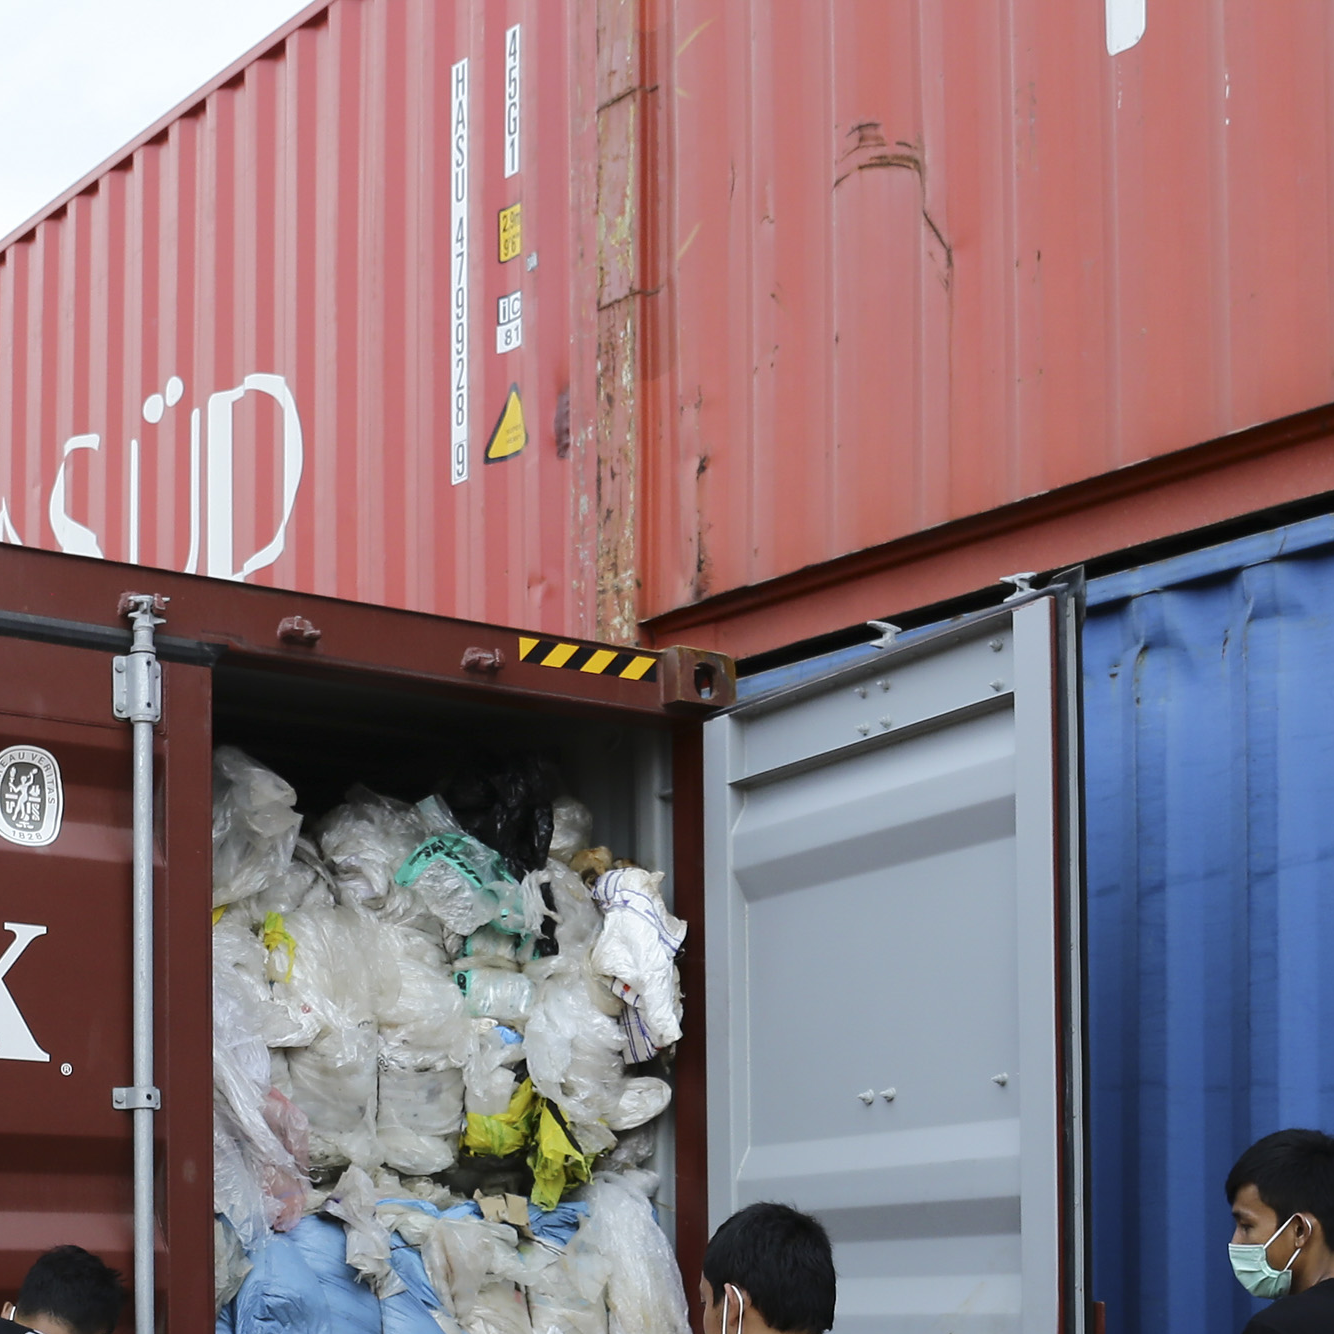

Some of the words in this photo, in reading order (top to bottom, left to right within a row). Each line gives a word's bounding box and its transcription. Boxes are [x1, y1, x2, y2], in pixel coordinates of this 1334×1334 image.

[508, 30, 517, 171] 45G1
[455, 65, 466, 203] HASU
[455, 216, 466, 427] 479928
[504, 325, 519, 346] 81
[454, 443, 465, 478] 9
[30, 752, 56, 805] VERITAS
[12, 830, 43, 840] 1828
